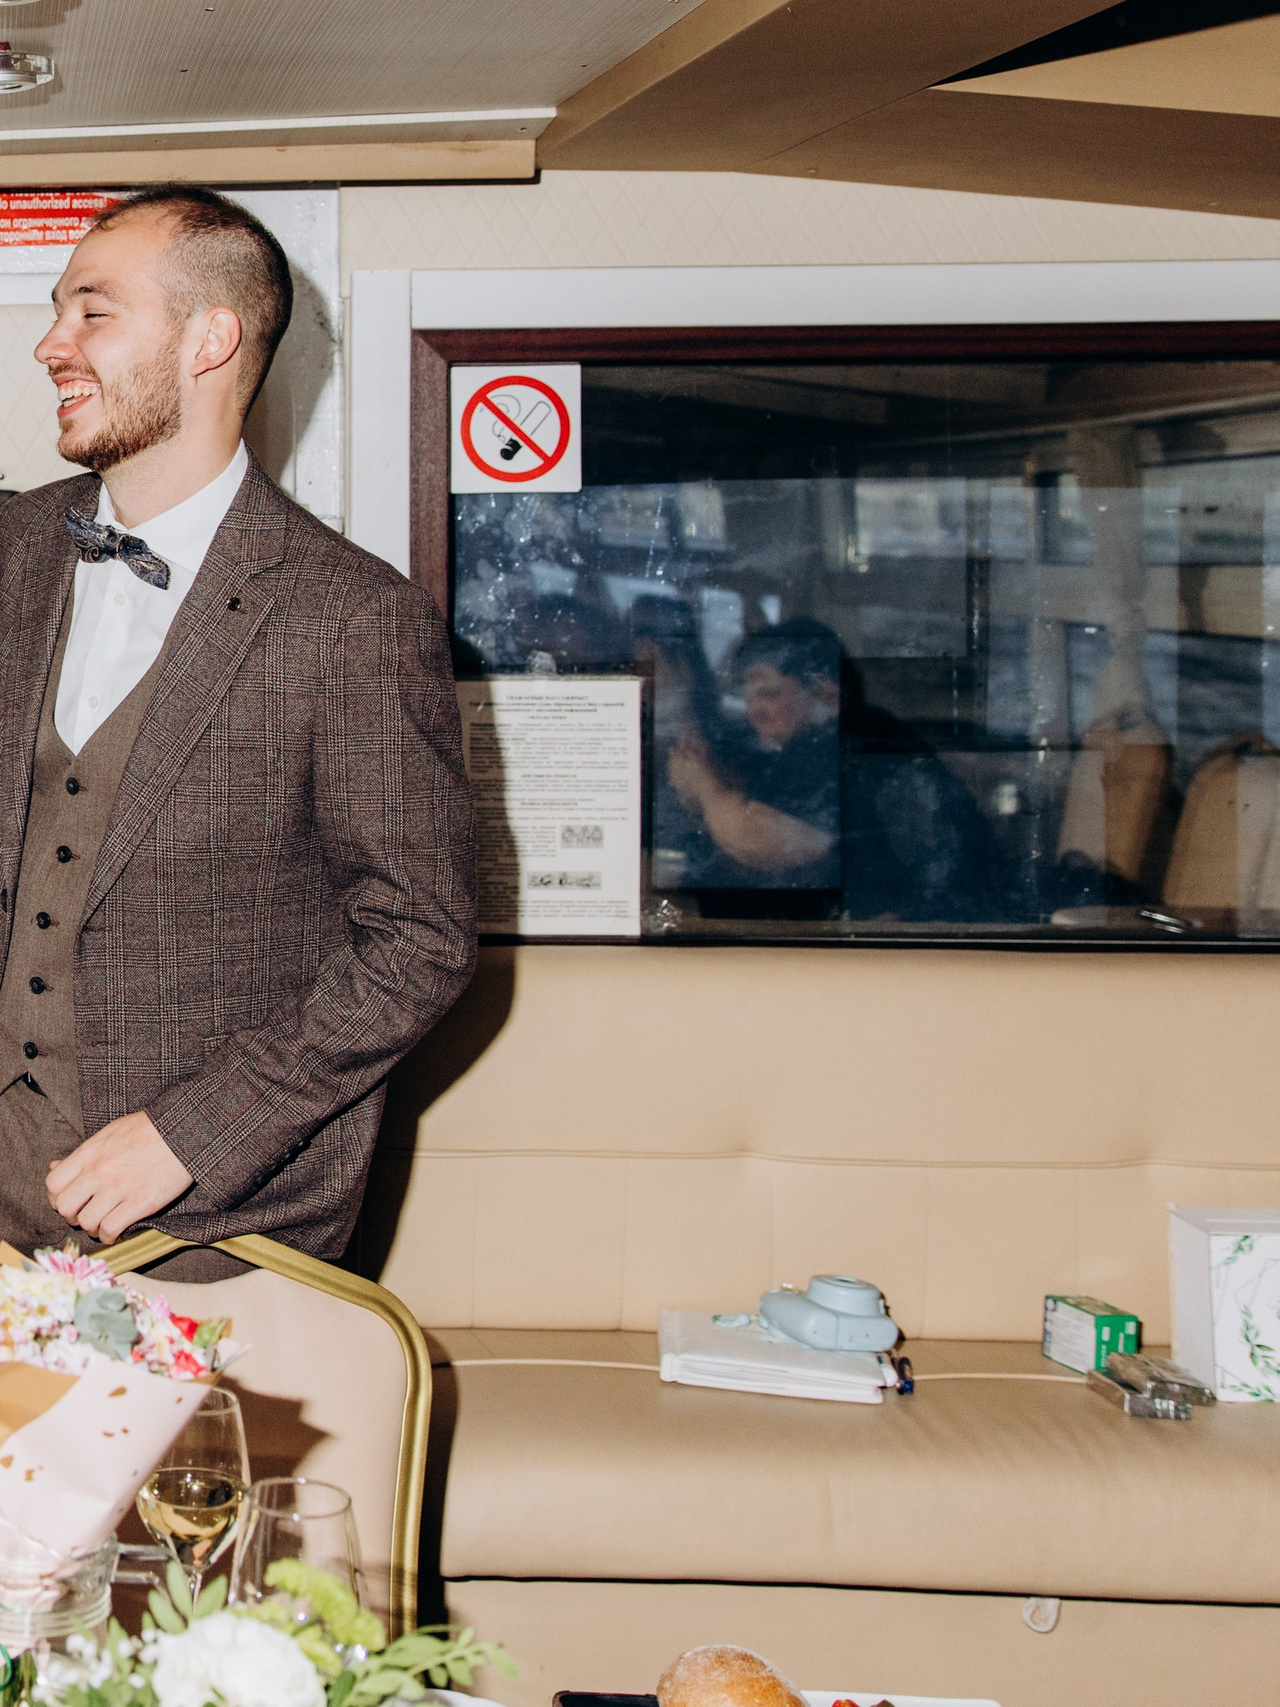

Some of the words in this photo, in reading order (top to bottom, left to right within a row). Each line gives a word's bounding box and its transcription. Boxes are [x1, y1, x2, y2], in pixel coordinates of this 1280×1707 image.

[9, 196, 70, 210] unauthorized
[71, 196, 107, 209] access!
[12, 216, 79, 230] ограниченного
[45, 229, 67, 242] вход
